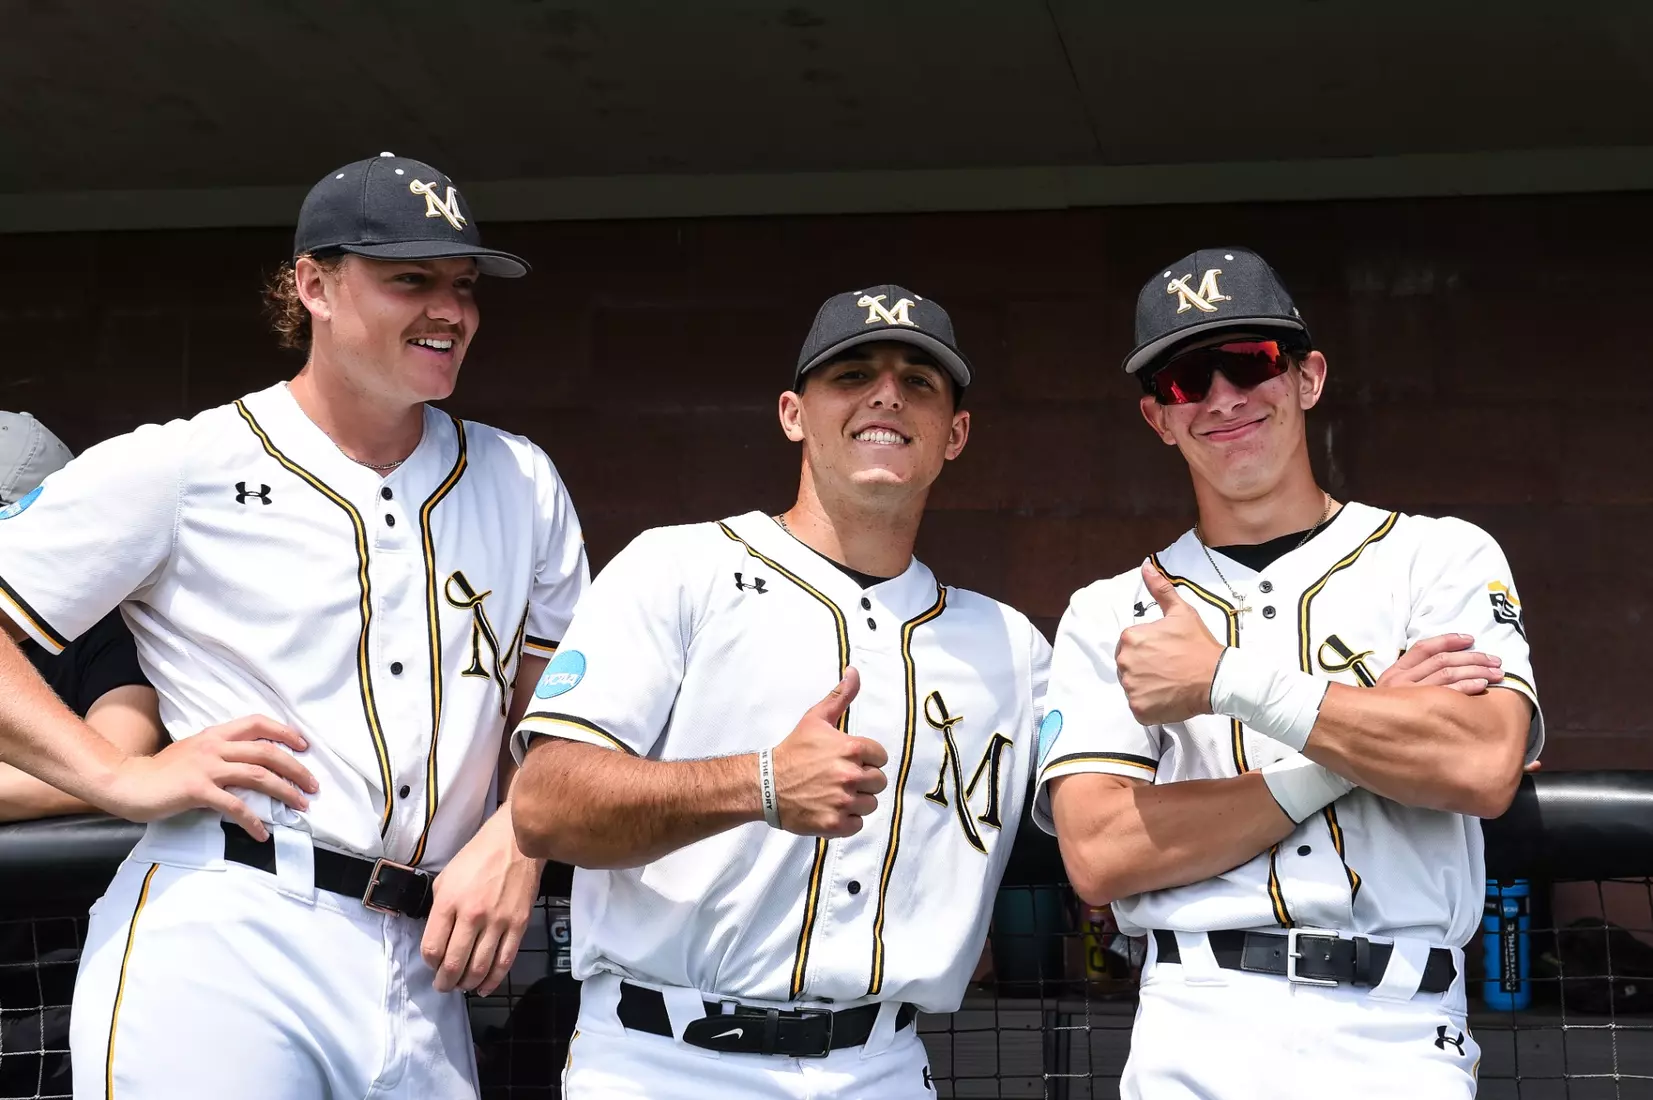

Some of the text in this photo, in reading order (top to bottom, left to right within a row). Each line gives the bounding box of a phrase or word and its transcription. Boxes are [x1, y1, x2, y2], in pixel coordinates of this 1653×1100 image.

[409, 179, 468, 231] M
[857, 294, 915, 326] M
[1167, 269, 1223, 314] M
[924, 690, 1014, 855] M
[764, 779, 773, 811] GLORY
[551, 920, 570, 943] G
